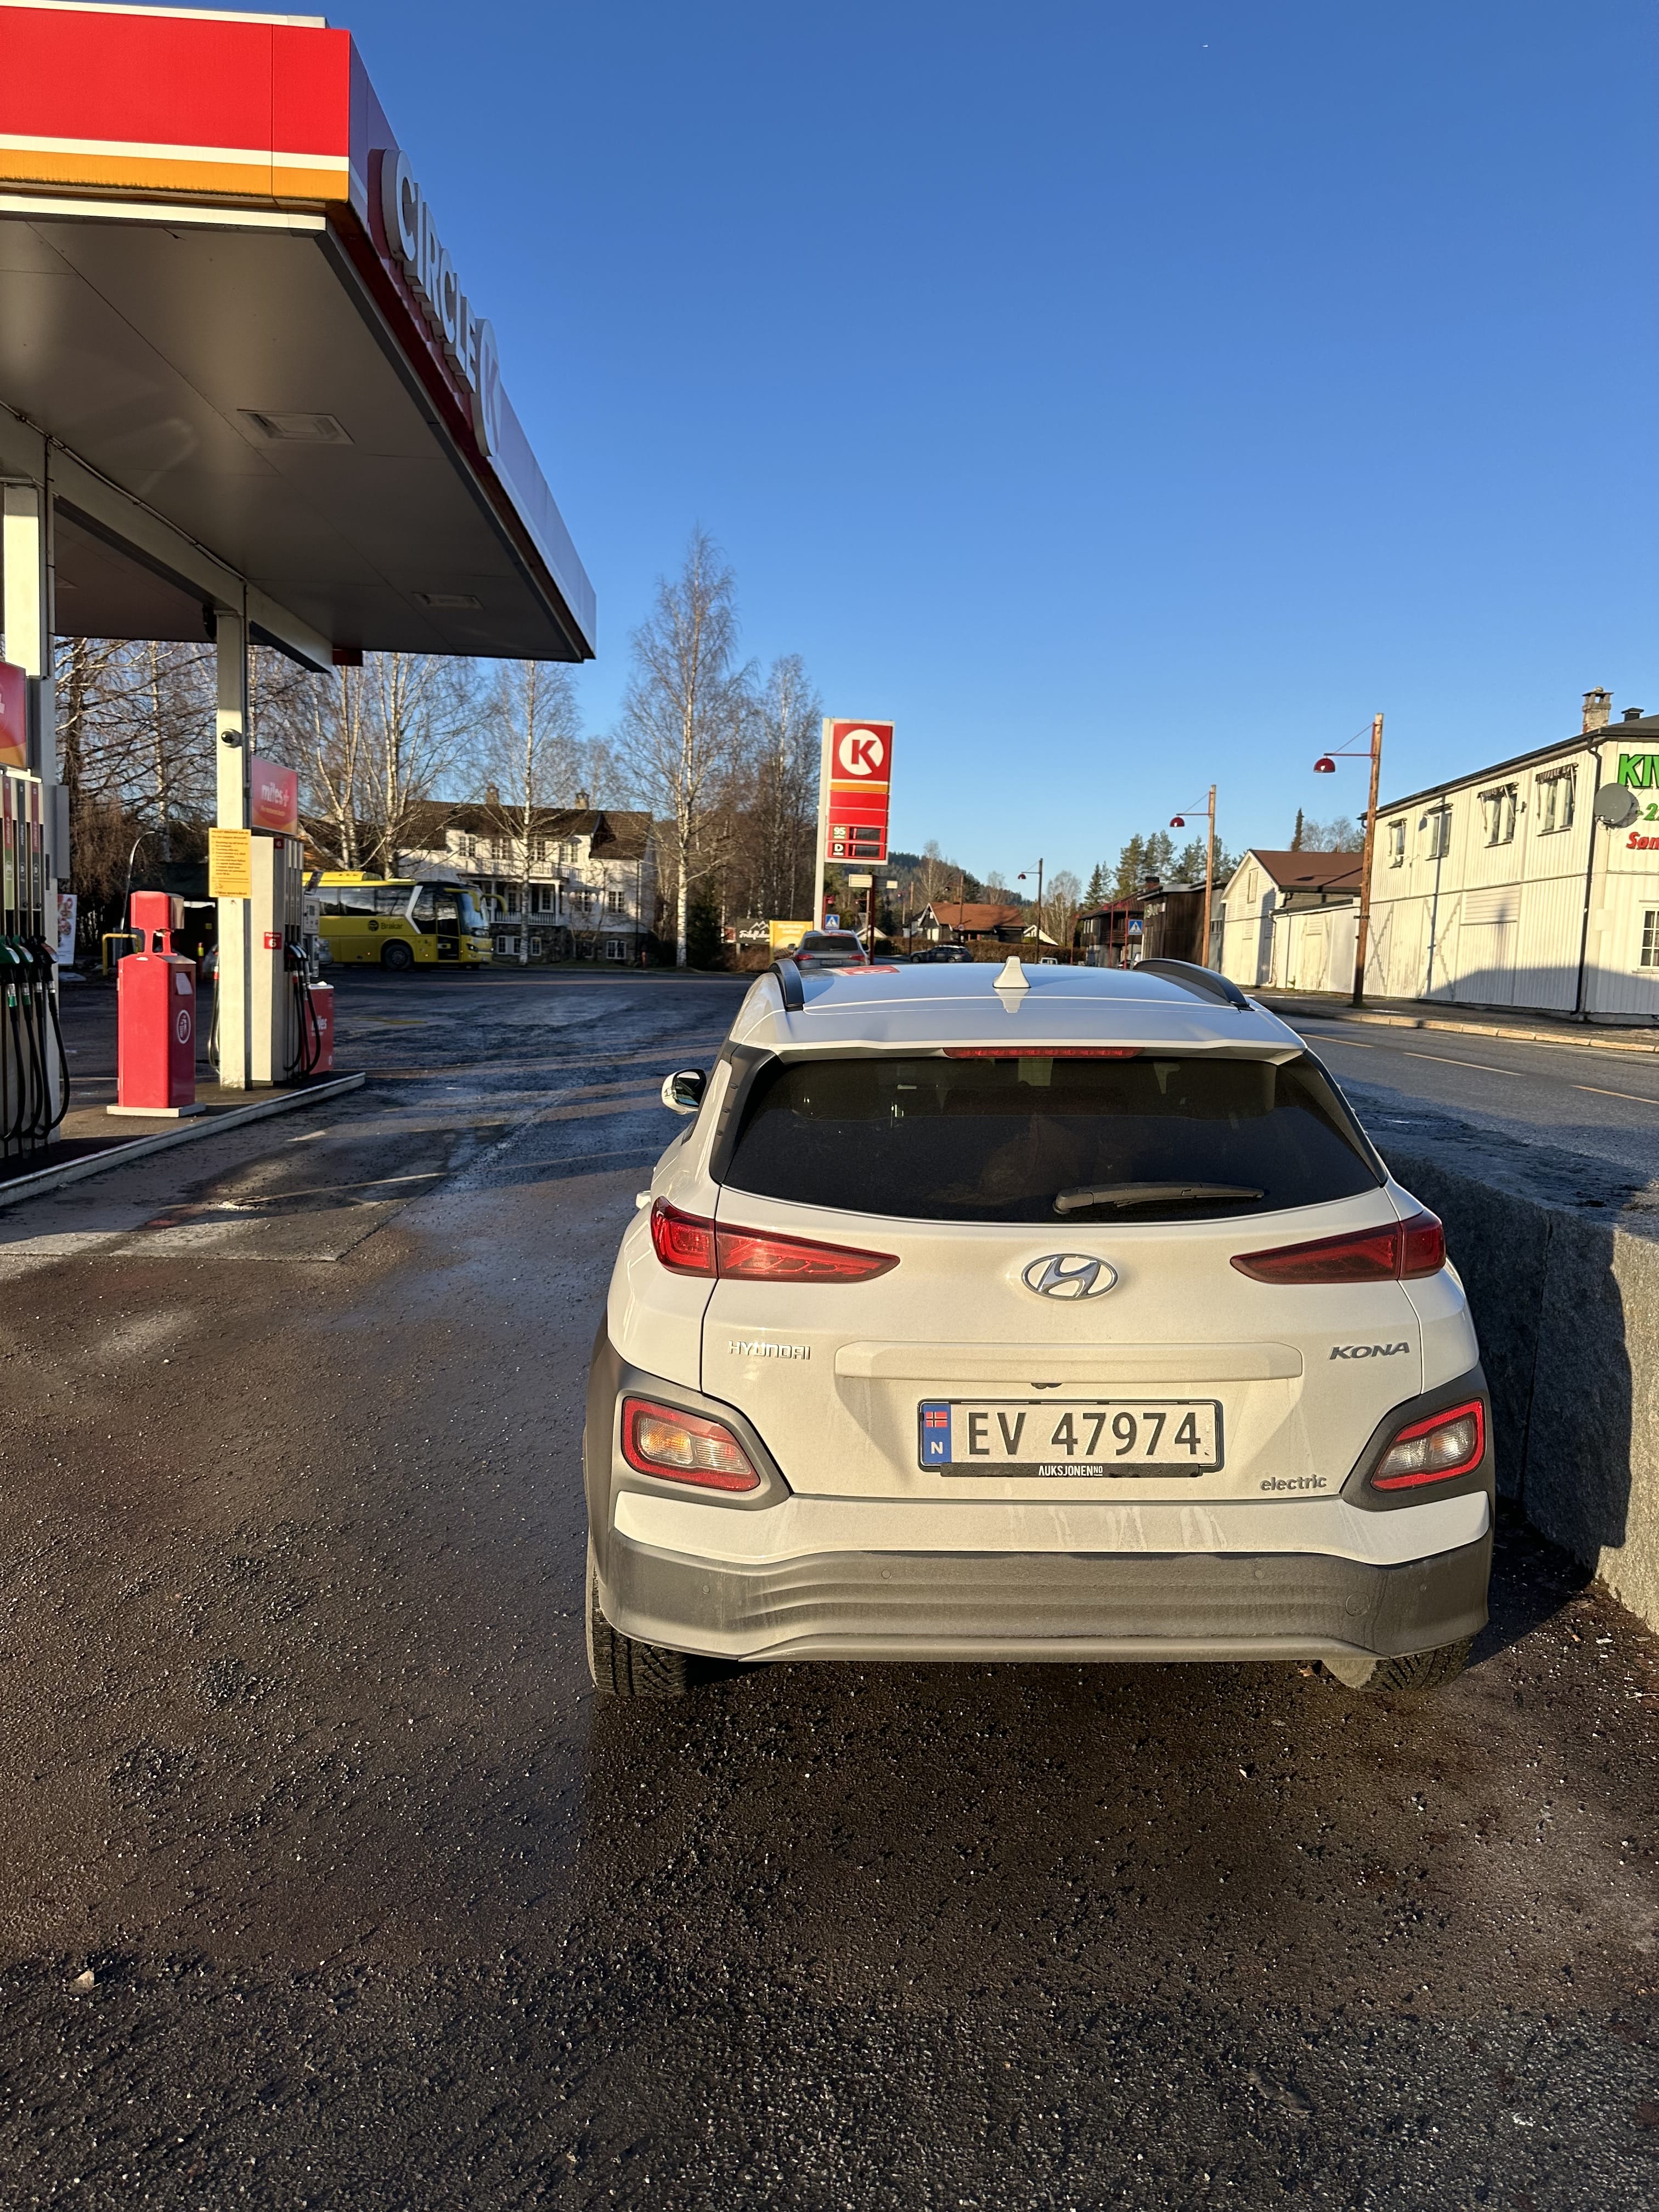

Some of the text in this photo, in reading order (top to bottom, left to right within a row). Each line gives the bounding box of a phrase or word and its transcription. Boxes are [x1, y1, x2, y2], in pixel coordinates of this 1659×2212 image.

[382, 149, 476, 394] CIRCLE
[833, 826, 846, 835] 95
[834, 843, 844, 852] D
[269, 939, 277, 948] 6
[728, 1340, 811, 1360] HYUNDAI
[1328, 1342, 1410, 1361] KONA
[968, 1412, 1201, 1456] EV 47974
[930, 1441, 944, 1454] N
[1260, 1474, 1327, 1491] electric
